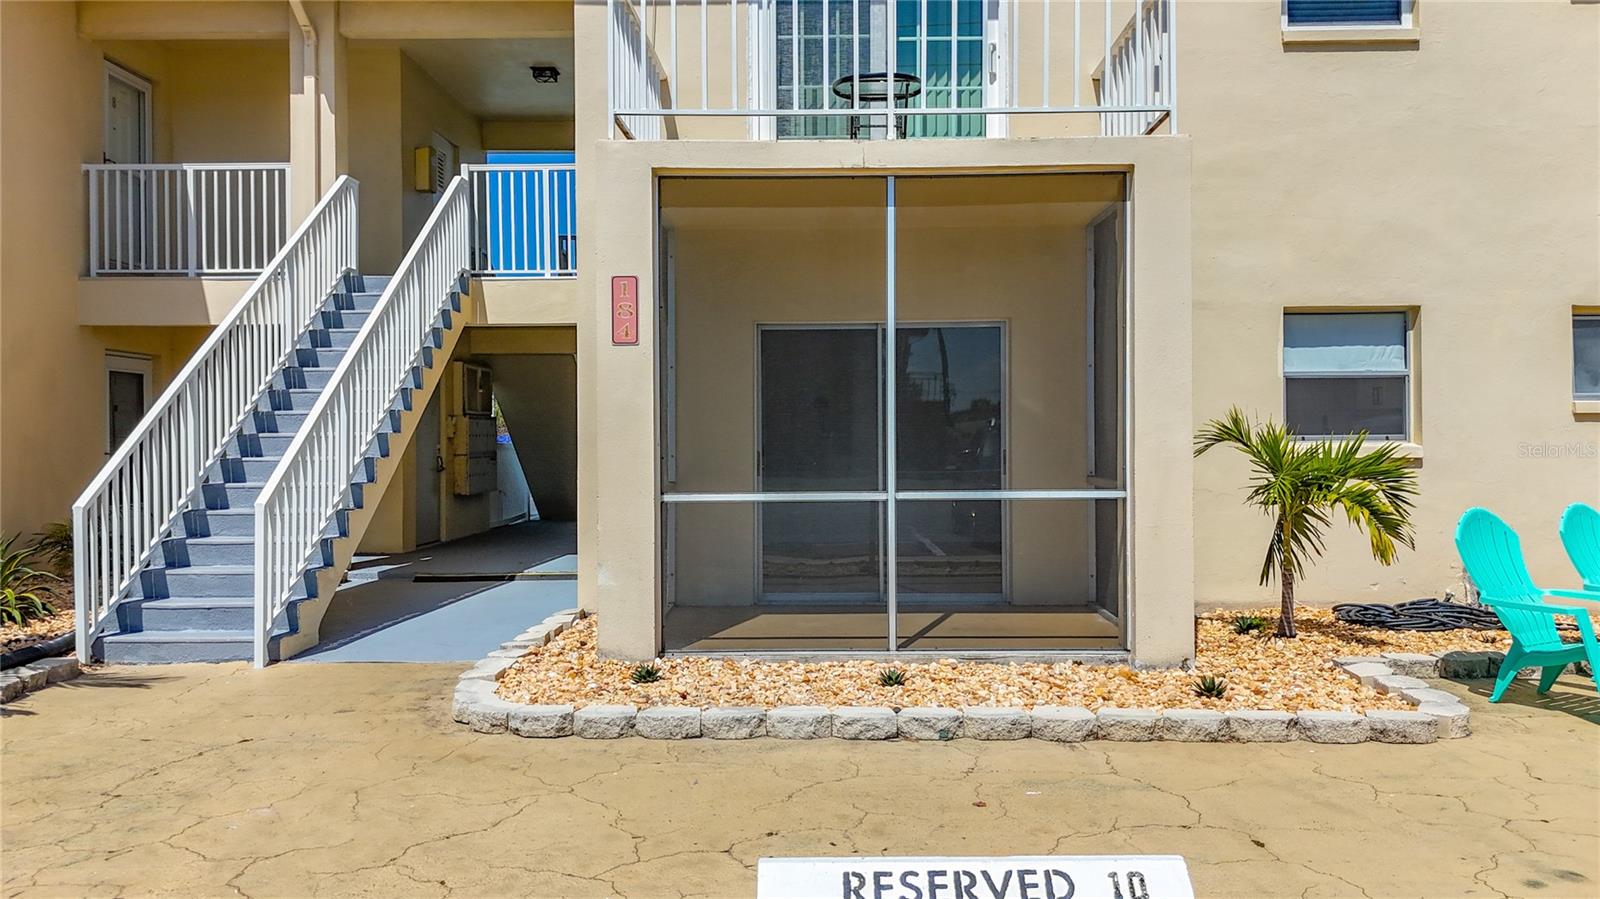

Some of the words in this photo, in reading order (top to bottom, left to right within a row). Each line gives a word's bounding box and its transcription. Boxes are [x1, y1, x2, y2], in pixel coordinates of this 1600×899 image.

[616, 281, 635, 339] 184
[842, 869, 1075, 899] RESERVED
[1107, 871, 1149, 899] 10
